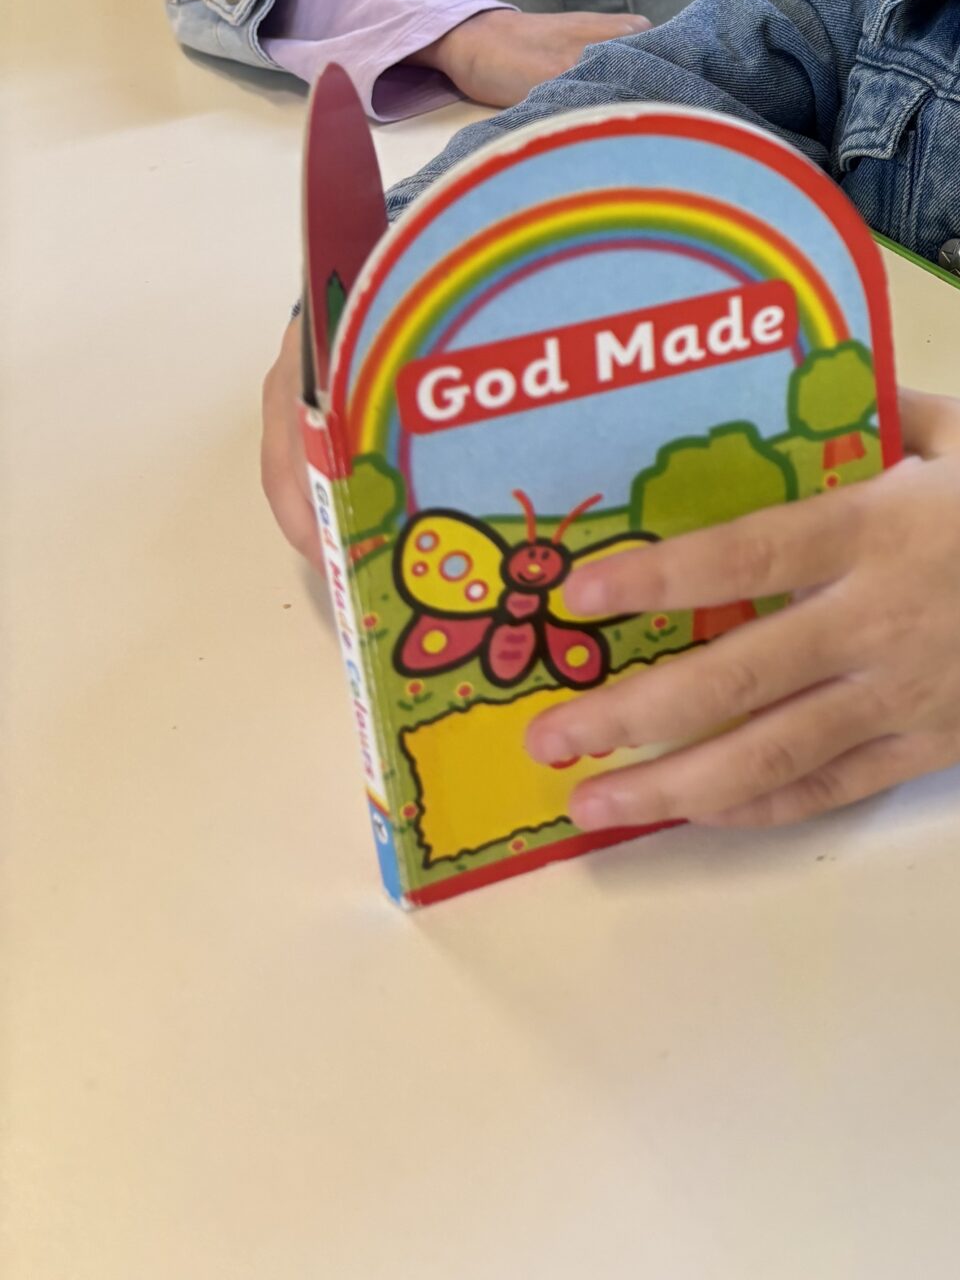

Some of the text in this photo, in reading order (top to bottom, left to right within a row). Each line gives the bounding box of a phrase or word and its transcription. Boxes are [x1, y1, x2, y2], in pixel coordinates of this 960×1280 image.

[416, 295, 785, 421] God Made
[315, 482, 338, 551] God
[329, 558, 353, 649] Made
